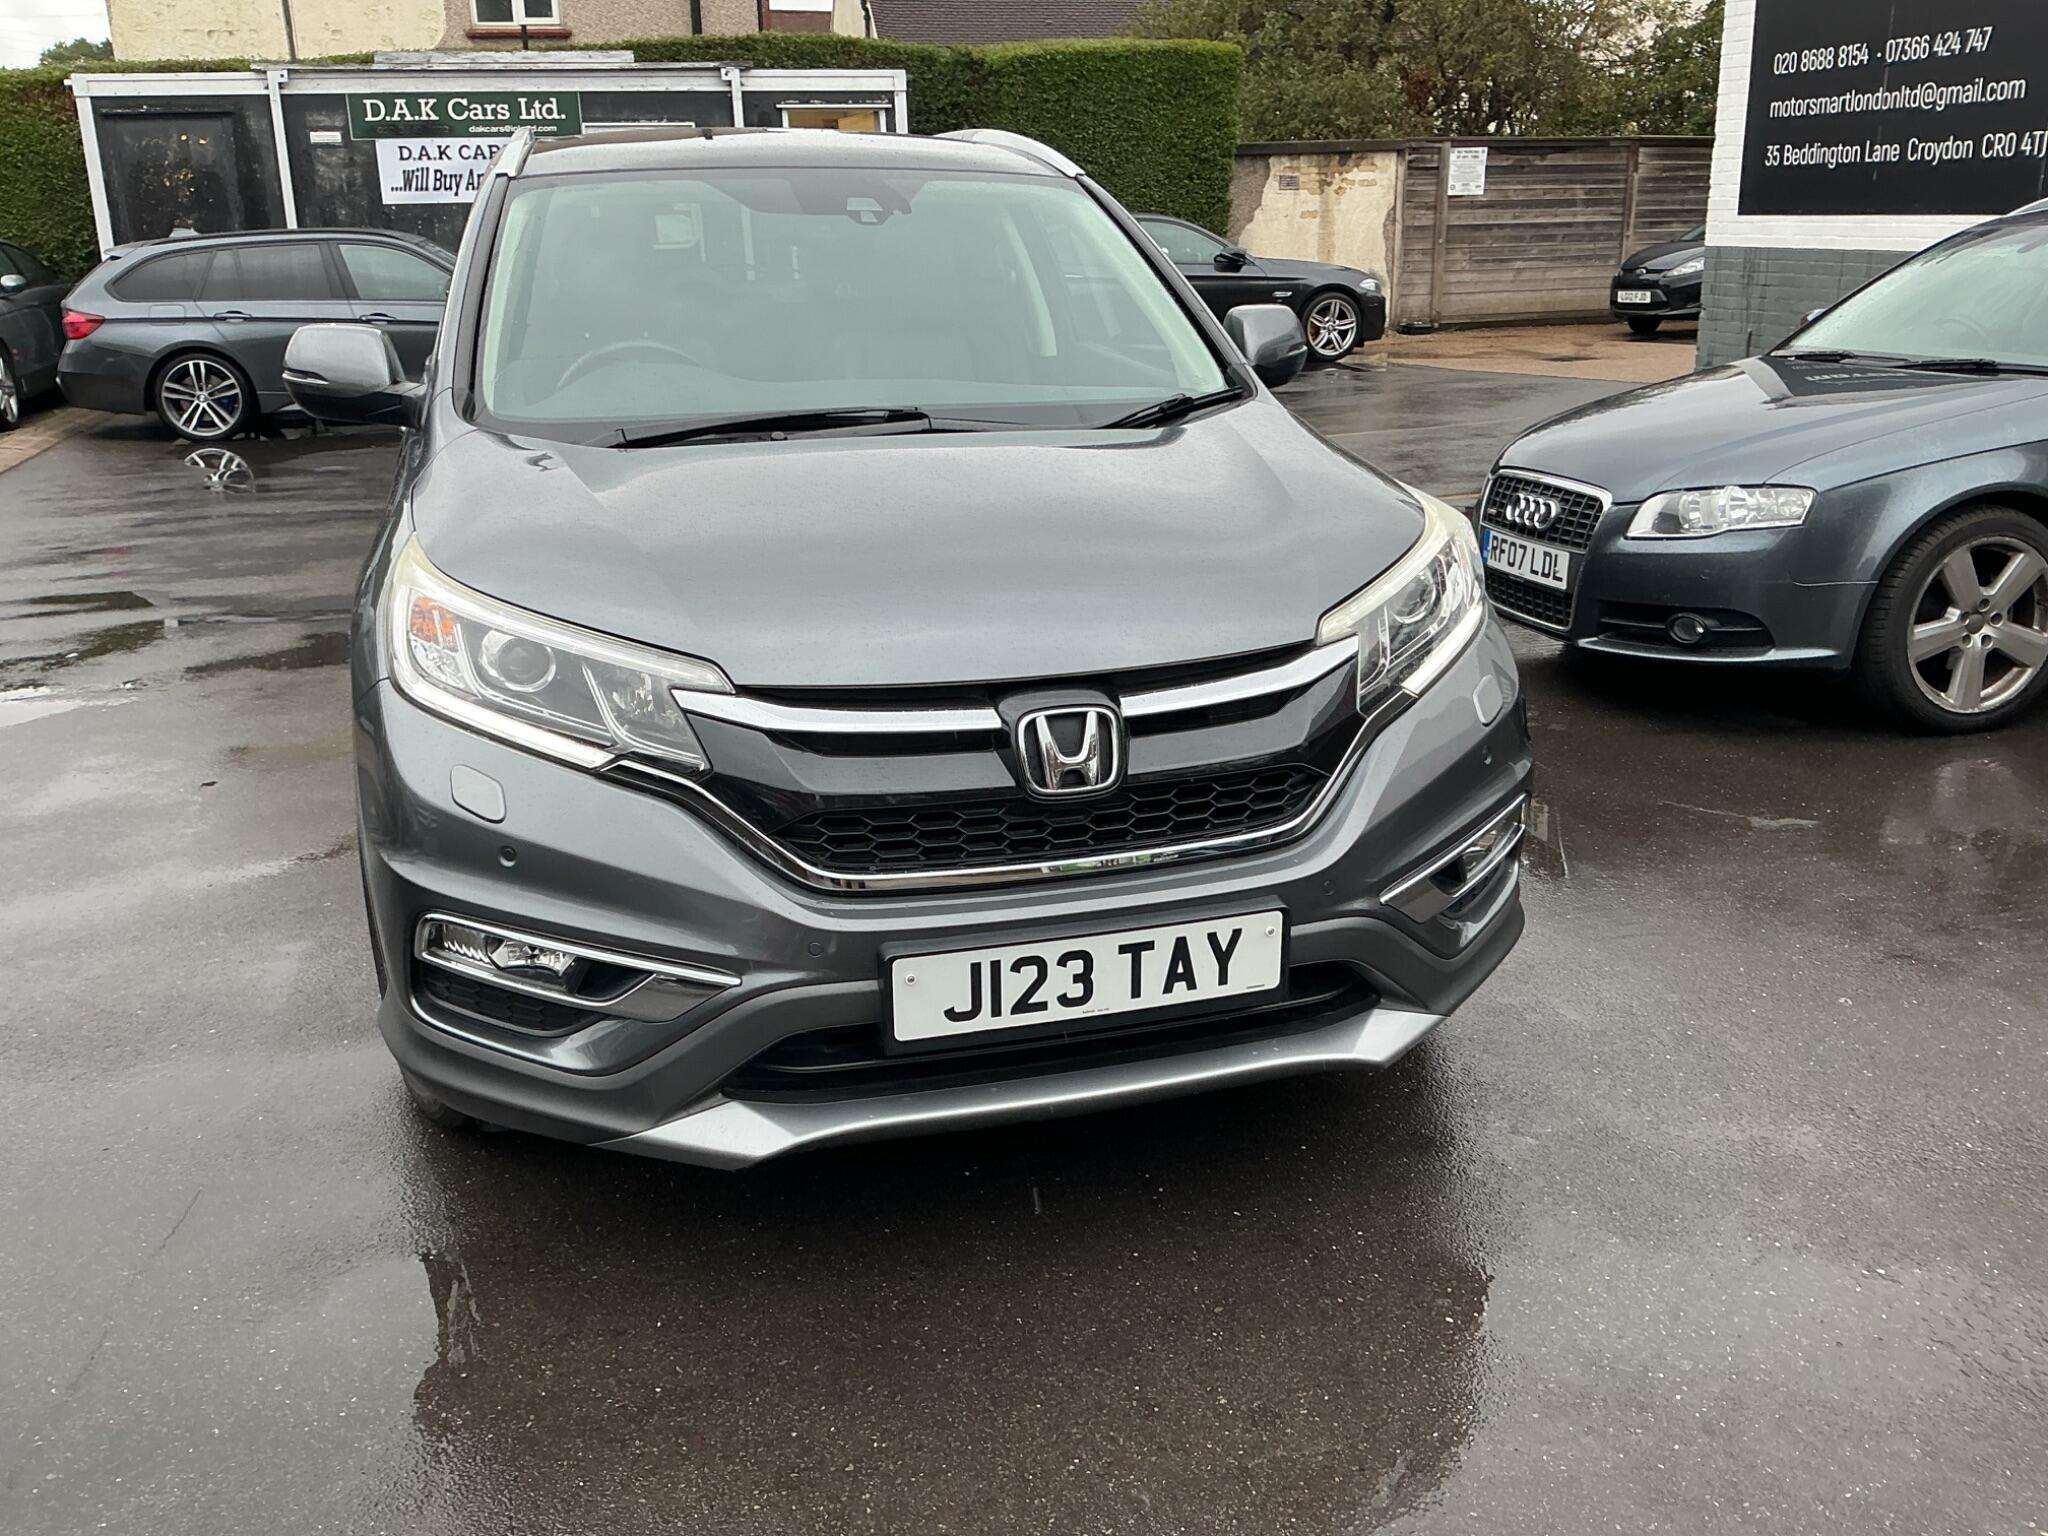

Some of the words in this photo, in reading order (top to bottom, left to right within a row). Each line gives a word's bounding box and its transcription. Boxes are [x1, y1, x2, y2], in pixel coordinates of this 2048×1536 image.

[1773, 51, 1797, 75] 020
[1800, 47, 1834, 72] 8688
[1838, 43, 1869, 68] 8154
[1885, 34, 1930, 64] 07366
[1933, 31, 1961, 57] 424
[1965, 26, 1993, 54] 747
[362, 98, 439, 122] D.A.K
[447, 97, 511, 121] Cars
[517, 97, 566, 120] Ltd.
[1769, 77, 2026, 119] motorsmartlondonltd@gmail.com
[398, 144, 453, 161] D.A.K
[458, 144, 504, 161] CAR
[1764, 144, 1780, 167] 35
[1783, 140, 1861, 170] Beddington
[1865, 139, 1900, 164] Lane
[1908, 135, 1973, 166] Croydon
[433, 169, 463, 197] Buy
[1490, 534, 1528, 571] RF07
[1529, 547, 1564, 583] LDL
[1117, 928, 1243, 1000] TAY
